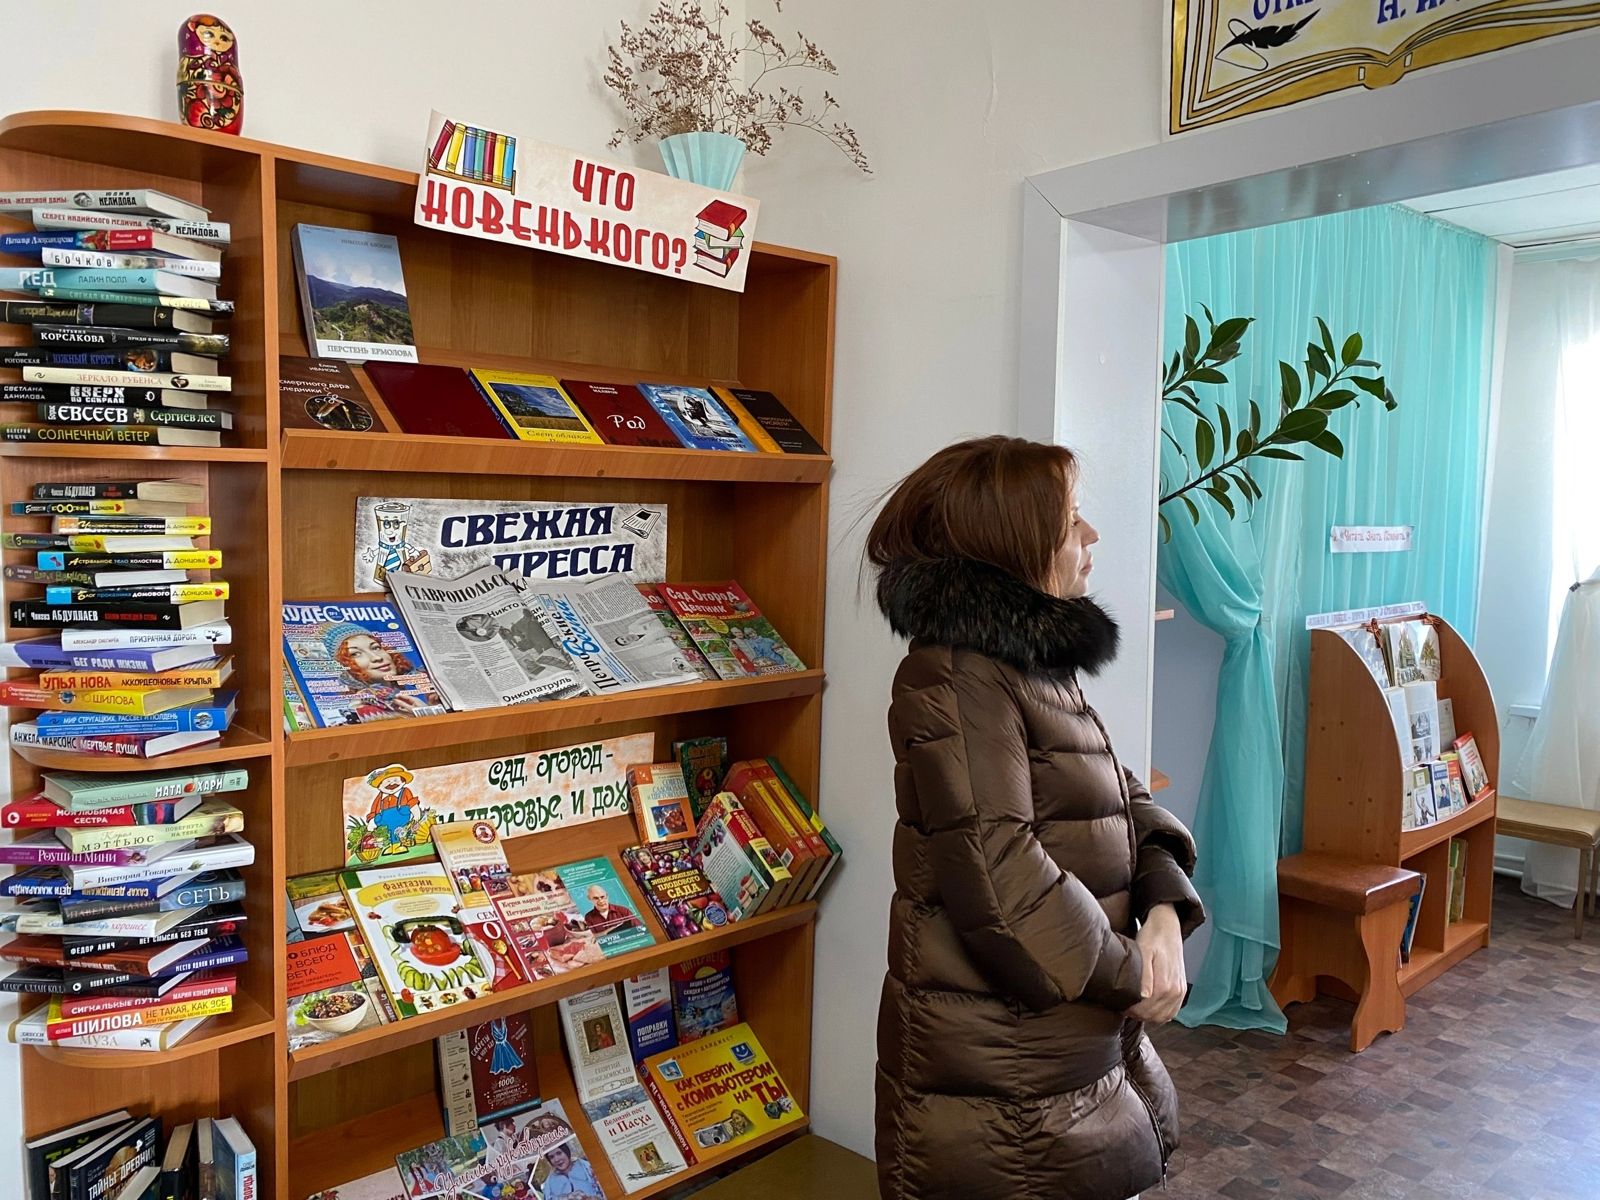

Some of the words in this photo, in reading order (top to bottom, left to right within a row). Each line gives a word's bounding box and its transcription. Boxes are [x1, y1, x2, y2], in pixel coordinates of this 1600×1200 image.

[572, 159, 635, 212] ЧТО
[98, 197, 137, 206] НЕЛИДОВА
[41, 212, 65, 220] СЕКРЕТ
[67, 215, 110, 225] ИНДИЙСКОГО
[175, 225, 220, 238] НЕЛИДОВА
[420, 180, 687, 274] НОВЕНЬКОГО?
[105, 275, 128, 284] ПОЛЛ
[40, 332, 105, 343] КОРСАКОВА
[327, 344, 369, 355] ПЕРСТЕНЬ
[371, 346, 413, 358] ЕРМОЛОВА
[52, 353, 88, 364] ЮЖНЫЙ
[90, 355, 115, 365] КРЕСТ
[77, 373, 118, 383] ЗЕРКАЛО
[121, 375, 162, 385] РУБЕНСА
[58, 406, 128, 423] ЕВСЕЕВ
[150, 410, 196, 423] Сергиев
[197, 414, 216, 423] лес
[607, 414, 646, 431] Род
[37, 427, 114, 441] СОЛНЕЧНЫЙ
[118, 430, 150, 442] ВЕТЕР
[64, 486, 96, 498] АБДУЛЛАЕВ
[440, 506, 615, 548] СВЕЖАЯ
[68, 557, 112, 566] Астральное
[173, 557, 206, 565] Донцова
[491, 543, 634, 580] ПРЕССА
[180, 589, 213, 597] Донцова
[666, 587, 692, 602] Сад
[692, 589, 740, 604] Огород
[487, 602, 520, 618] Никто
[677, 601, 726, 614] Цветник
[52, 610, 99, 622] АБДУЛЛАЕВ
[129, 634, 172, 644] ПРИЗРАЧНАЯ
[172, 633, 197, 642] ДОРОГА
[72, 656, 88, 667] БЕГ
[91, 658, 115, 668] РАДИ
[116, 658, 148, 670] ЖИЗНИ
[80, 675, 112, 689] НОВА
[121, 678, 181, 687] АККОРДЕОНОВЫЕ
[183, 676, 213, 686] КРЫЛЬЯ
[502, 675, 572, 703] Онкопатруль
[92, 692, 135, 706] ШИЛОВА
[14, 731, 41, 746] АНЖЕЛА
[42, 736, 77, 749] МАРСОНС
[80, 739, 114, 752] МЕРТВЫЕ
[115, 743, 139, 756] ДУШИ
[535, 743, 603, 783] ОГОРОД
[155, 784, 182, 799] МАТА
[196, 779, 224, 793] ХАРИ
[570, 790, 584, 815] И
[592, 779, 632, 818] ДОХ
[182, 829, 199, 837] ТЕБЕ
[80, 835, 155, 852] МЭТТЬЮС
[84, 851, 117, 863] Мини
[97, 871, 142, 884] Виктория
[143, 865, 183, 878] Токарева
[54, 882, 72, 896] ДЕТИ
[382, 879, 434, 891] Фантазии
[667, 883, 702, 899] САДА
[177, 887, 230, 906] СЕТЬ
[476, 909, 499, 921] СЕМ
[139, 936, 150, 945] НЕТ
[152, 933, 179, 943] СМЫСЛА
[180, 930, 192, 939] БЕЗ
[193, 927, 209, 936] ТЕБЯ
[70, 944, 94, 955] ФЕДОР
[300, 942, 338, 957] БЛЮД
[296, 953, 336, 968] ВСЕГО
[175, 964, 192, 972] МЕСТО
[287, 969, 318, 981] ВЕТА
[192, 986, 229, 998] КОНДРАТОВА
[71, 999, 133, 1015] СИГНАЛЬНЫЕ
[145, 1008, 159, 1018] НЕ
[191, 1001, 208, 1011] КАК
[72, 1012, 143, 1036] ШИЛОВА
[636, 1019, 669, 1037] ПОПРАВКИ
[79, 1035, 118, 1047] МУЗА
[498, 1076, 515, 1088] 1000
[674, 1080, 696, 1094] КАК
[695, 1061, 736, 1084] ПЕРЕЙТИ
[682, 1062, 776, 1109] КОМПЬЮТЕРОМ
[733, 1090, 753, 1105] НА
[750, 1076, 788, 1105] ТЫ
[617, 1113, 652, 1133] Пасха
[88, 1173, 117, 1196] ТАЙНЫ
